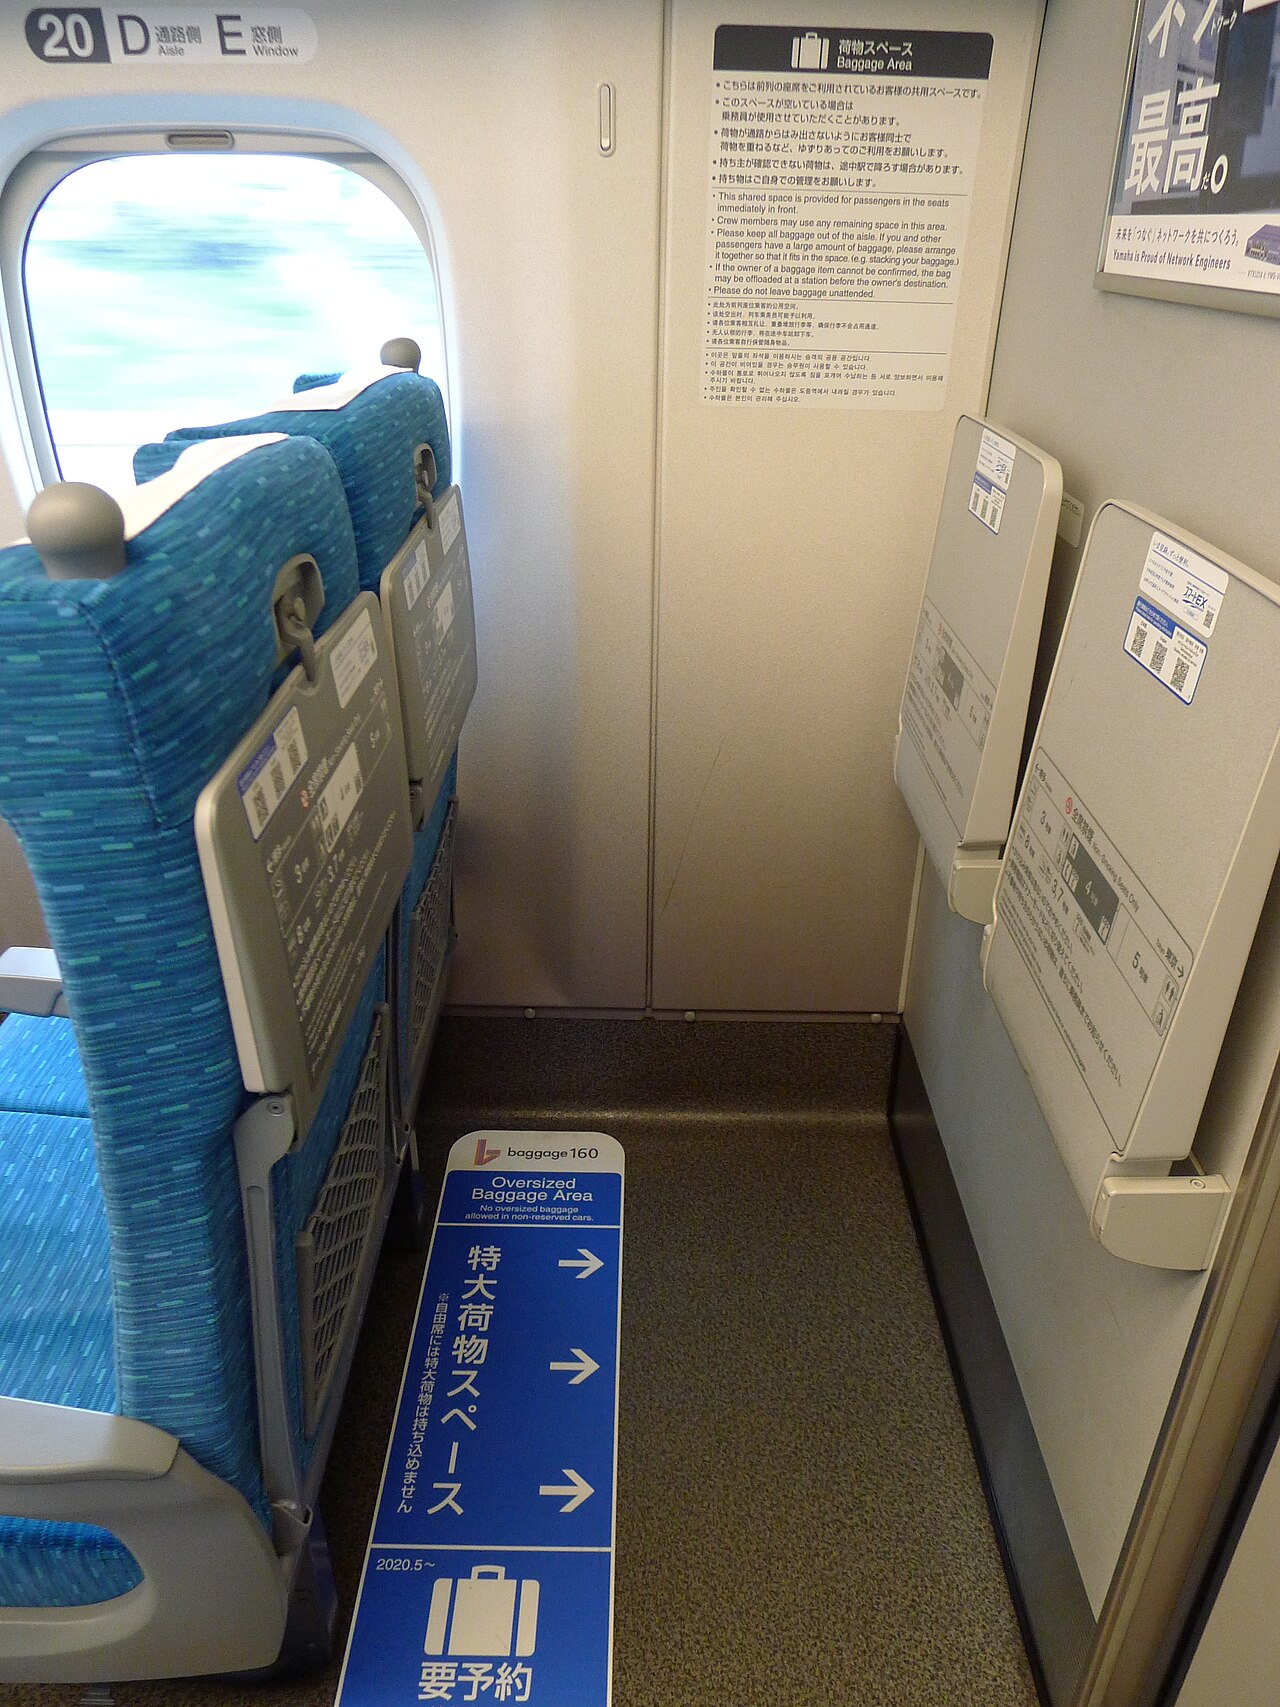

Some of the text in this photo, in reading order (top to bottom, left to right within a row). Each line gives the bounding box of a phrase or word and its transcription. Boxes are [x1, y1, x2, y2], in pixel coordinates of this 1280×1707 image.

[38, 13, 94, 57] 20
[117, 14, 150, 56] D
[155, 25, 202, 44] 通路側
[216, 14, 247, 56] E
[251, 26, 283, 44] 窓側
[158, 46, 185, 57] Aisle
[254, 45, 299, 57] Window
[839, 39, 913, 57] 荷物スペース
[837, 57, 912, 72] Baggage Area
[719, 192, 735, 200] This
[738, 193, 766, 201] shared
[768, 194, 792, 203] space
[795, 194, 801, 202] is
[804, 194, 839, 204] provided
[841, 196, 851, 204] for
[854, 197, 900, 207] passengers
[912, 198, 925, 206] the
[928, 199, 949, 207] seats
[717, 203, 798, 214] immediately in front.
[717, 216, 738, 225] Crew
[740, 218, 778, 226] members
[816, 221, 831, 229] any
[833, 220, 873, 230] remaining
[875, 222, 899, 230] space
[911, 222, 924, 230] this
[927, 223, 947, 231] area.
[717, 229, 744, 237] Please
[747, 230, 766, 239] keep
[769, 230, 777, 238] all
[780, 231, 815, 240] baggage
[857, 233, 877, 241] aisle.
[887, 235, 901, 243] you
[921, 235, 941, 243] other
[716, 242, 762, 250] passengers
[794, 242, 813, 252] large
[848, 243, 856, 251] of
[858, 244, 894, 254] baggage,
[896, 245, 923, 254] please
[925, 247, 956, 256] arrange
[715, 251, 720, 259] it
[722, 251, 753, 261] together
[766, 252, 781, 260] that
[789, 253, 800, 261] fits
[802, 253, 809, 261] in
[811, 253, 823, 261] the
[869, 256, 900, 265] stacking
[902, 257, 918, 266] your
[1113, 249, 1231, 271] Yamaha is Proud of Network Engineers
[716, 263, 720, 271] If
[723, 263, 735, 272] the
[764, 264, 772, 272] of
[781, 265, 815, 275] baggage
[818, 266, 834, 274] item
[866, 267, 875, 275] be
[878, 268, 919, 277] confirmed,
[921, 269, 934, 277] the
[936, 269, 951, 279] bag
[714, 276, 731, 284] may
[734, 275, 743, 283] be
[746, 275, 782, 284] offloaded
[802, 276, 828, 285] station
[830, 277, 854, 285] before
[857, 278, 869, 286] the
[904, 279, 948, 289] destination.
[714, 286, 740, 294] Please
[743, 286, 753, 295] do
[755, 287, 767, 295] not
[770, 288, 790, 296] leave
[793, 288, 827, 298] baggage
[492, 1177, 576, 1189] Oversized
[472, 1189, 593, 1203] Baggage Area
[495, 1205, 538, 1213] oversized
[540, 1205, 578, 1215] baggage
[427, 1245, 502, 1516] 特大荷物スペース
[418, 1662, 533, 1702] 要予約
